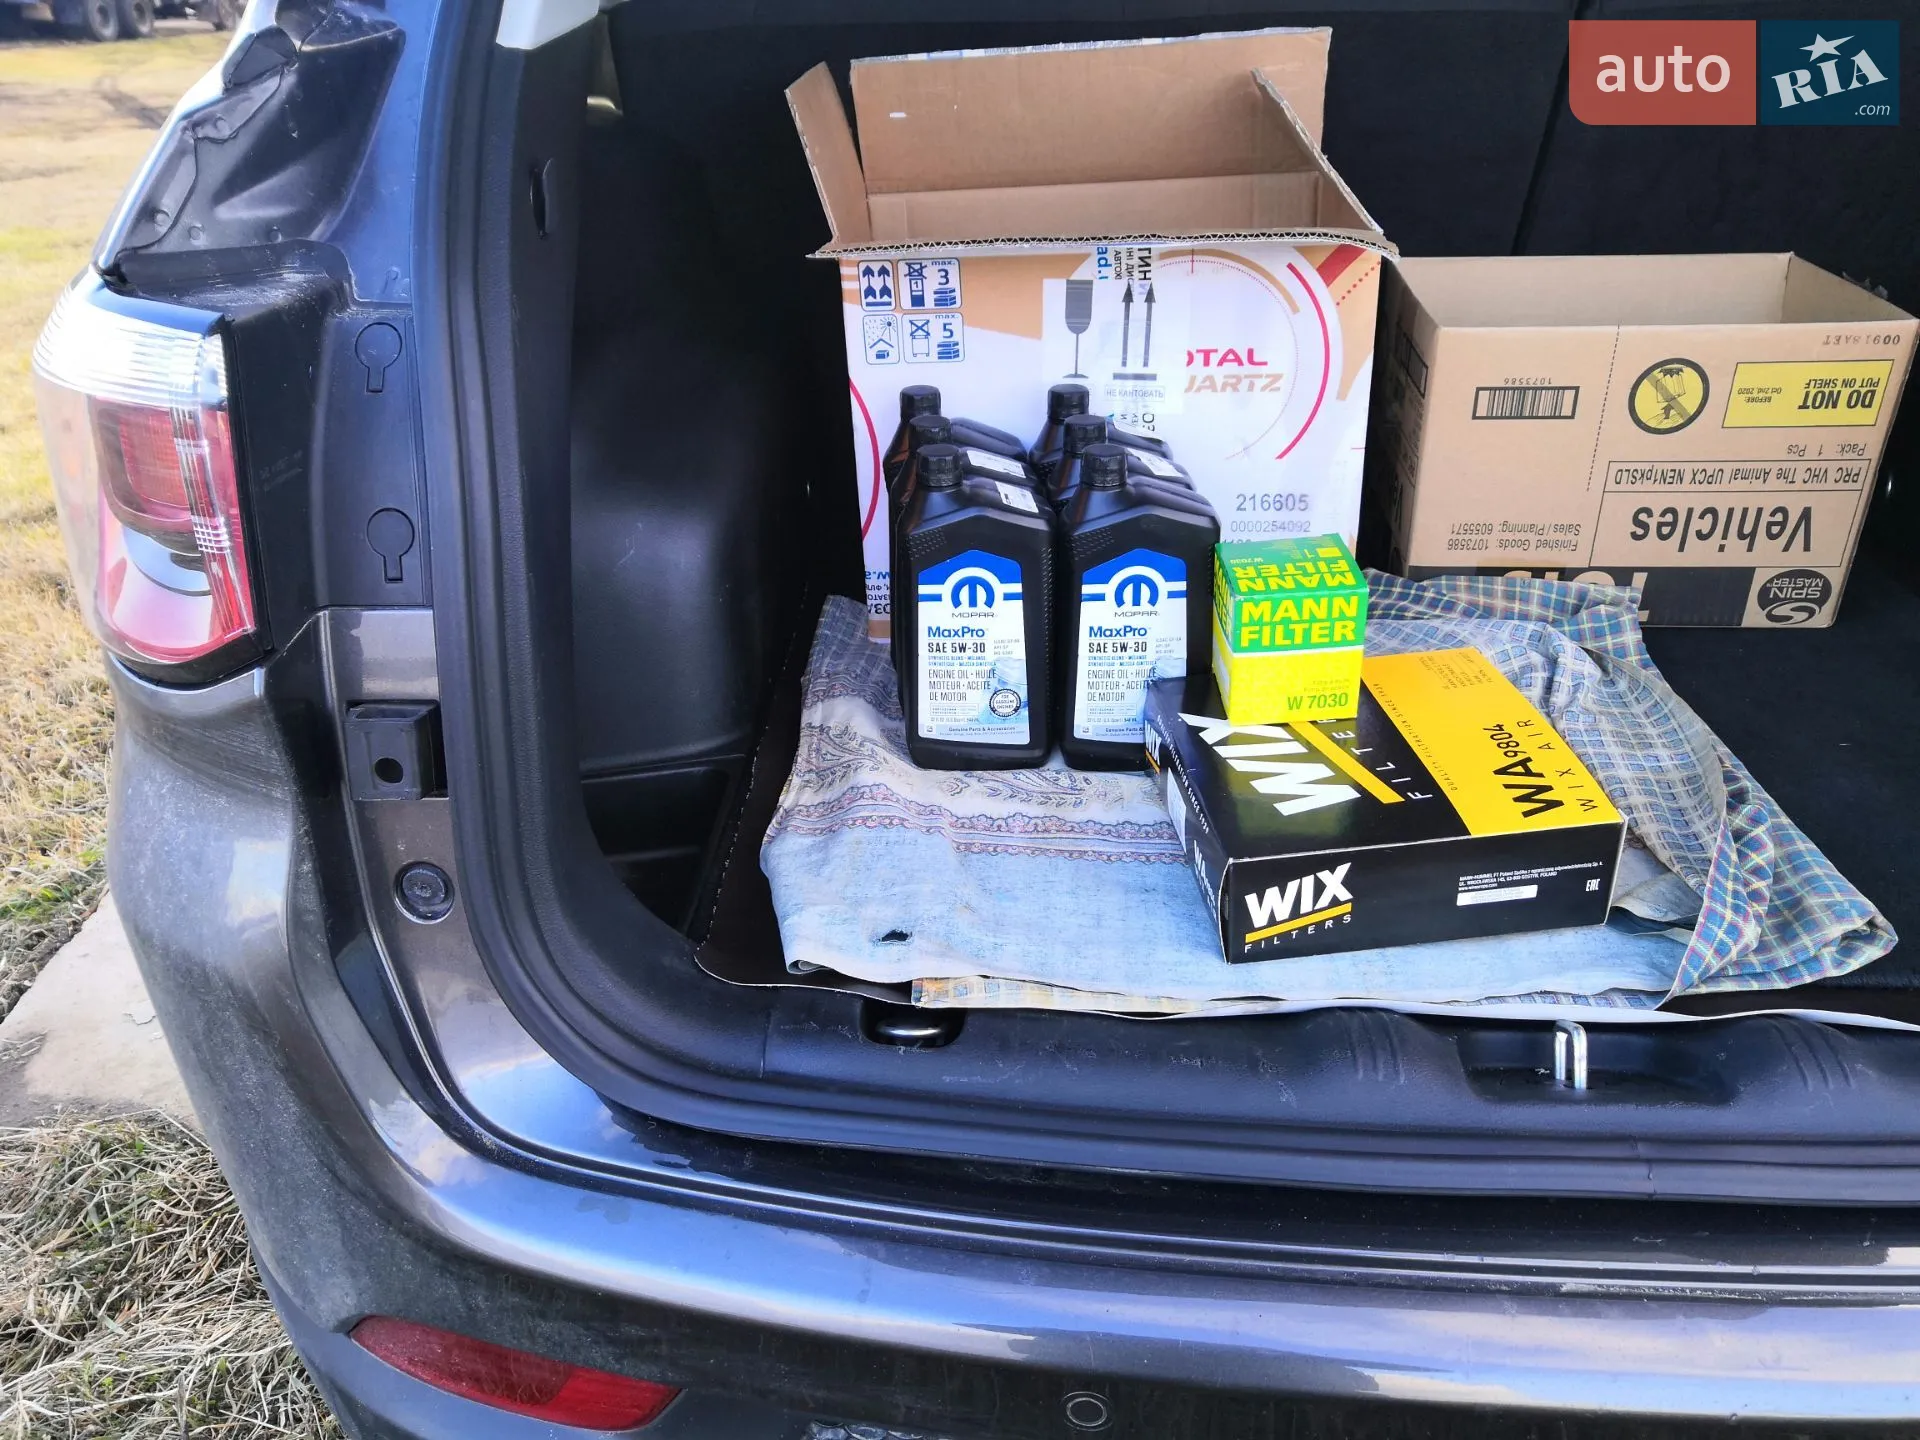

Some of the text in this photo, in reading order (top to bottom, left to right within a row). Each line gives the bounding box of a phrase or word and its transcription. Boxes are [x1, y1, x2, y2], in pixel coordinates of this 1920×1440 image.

[937, 268, 950, 286] 3
[942, 322, 955, 339] 5
[1503, 377, 1552, 386] 1073586
[1804, 377, 1881, 389] PUT ON SHELF
[1798, 390, 1877, 411] DO NOT
[1787, 444, 1806, 456] Pcs
[1836, 443, 1867, 456] Pack:
[1614, 467, 1861, 486] PRC VHC The Animal UPCX NEN1pkSLD
[1235, 493, 1310, 512] 216605
[1230, 520, 1311, 533] 0000254092
[1450, 522, 1494, 536] 6055571
[1629, 506, 1813, 553] Vehicles
[1447, 538, 1578, 552] Finished Goods: 1073586
[1232, 560, 1350, 579] FILTER
[1236, 572, 1357, 592] MANN
[1769, 587, 1821, 599] SPIN
[1114, 610, 1158, 618] MOPAR
[1241, 595, 1360, 624] MANN
[927, 625, 986, 638] MaxPro
[1088, 625, 1147, 638] MaxPro
[1240, 620, 1357, 648] FILTER
[927, 642, 986, 653] SAE 5W-30
[1088, 642, 1109, 653] SAE
[1112, 641, 1147, 653] 5W-30
[928, 668, 997, 679] ENGINE OIL HUILE
[1087, 669, 1116, 679] ENGINE
[1117, 669, 1129, 679] OIL
[928, 680, 991, 690] MOTEUR ACEITE
[1087, 680, 1120, 690] MOTEUR
[929, 692, 967, 702] DE MOTOR
[1087, 692, 1125, 702] DE MOTOR
[1287, 692, 1349, 711] W 7030
[1482, 723, 1565, 819] WA9804
[1516, 719, 1599, 812] WIX AIR
[1244, 862, 1354, 929] WIX
[1244, 914, 1352, 953] FILTERS
